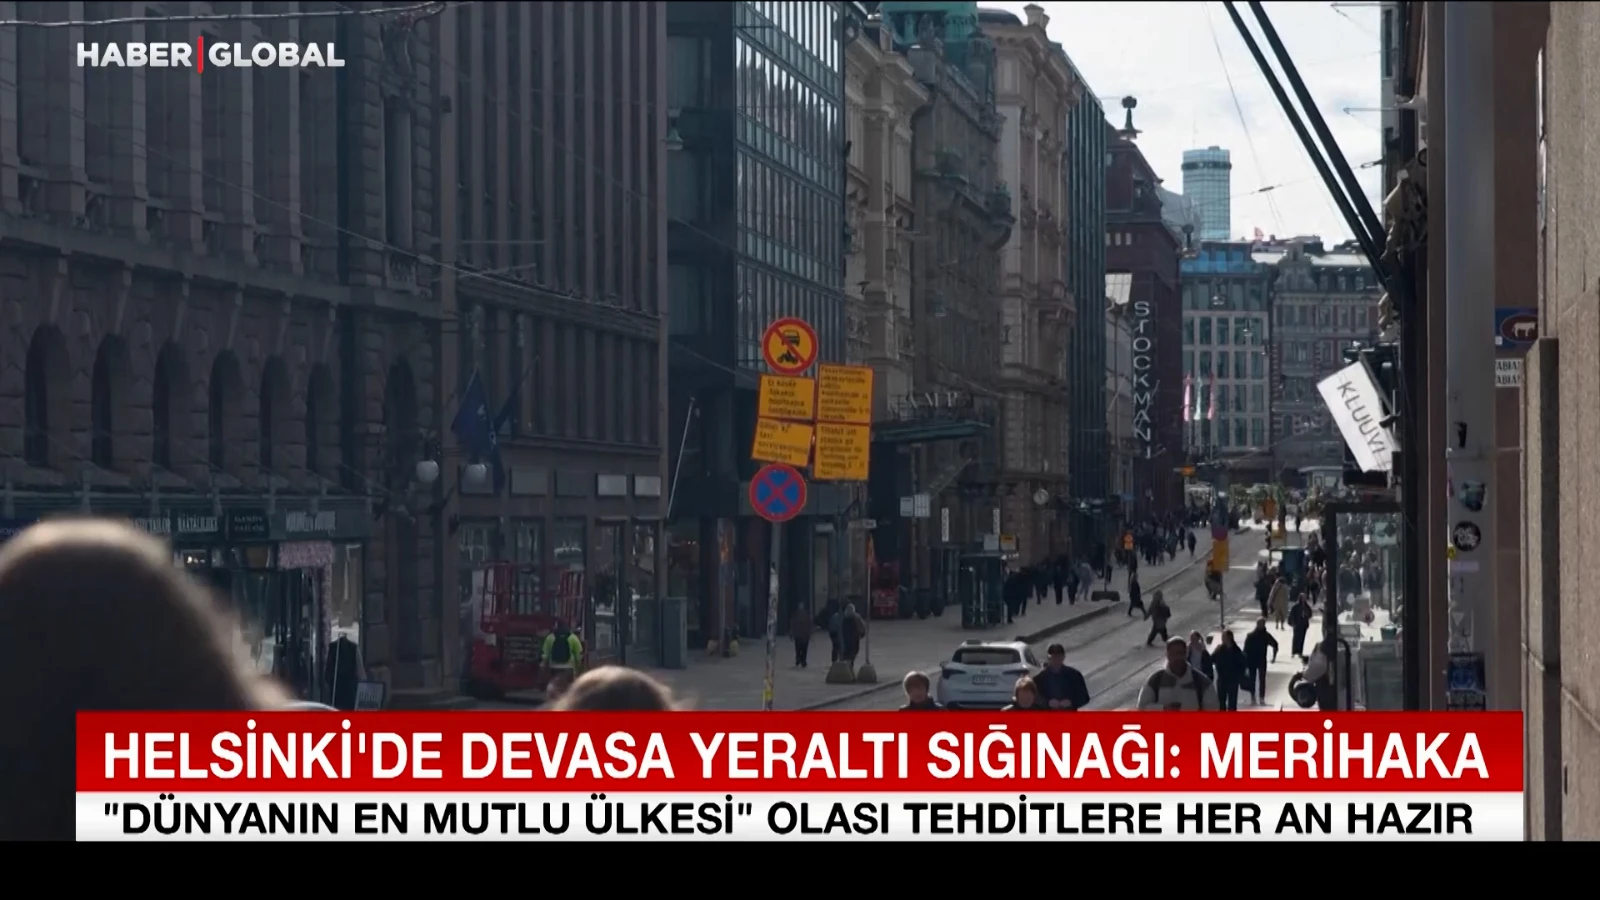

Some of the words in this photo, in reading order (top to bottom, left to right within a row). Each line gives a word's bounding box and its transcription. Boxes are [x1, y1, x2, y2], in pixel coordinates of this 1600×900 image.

[1495, 360, 1520, 371] ABIA
[1495, 374, 1520, 385] ABIA
[1336, 381, 1387, 454] KLUUVI
